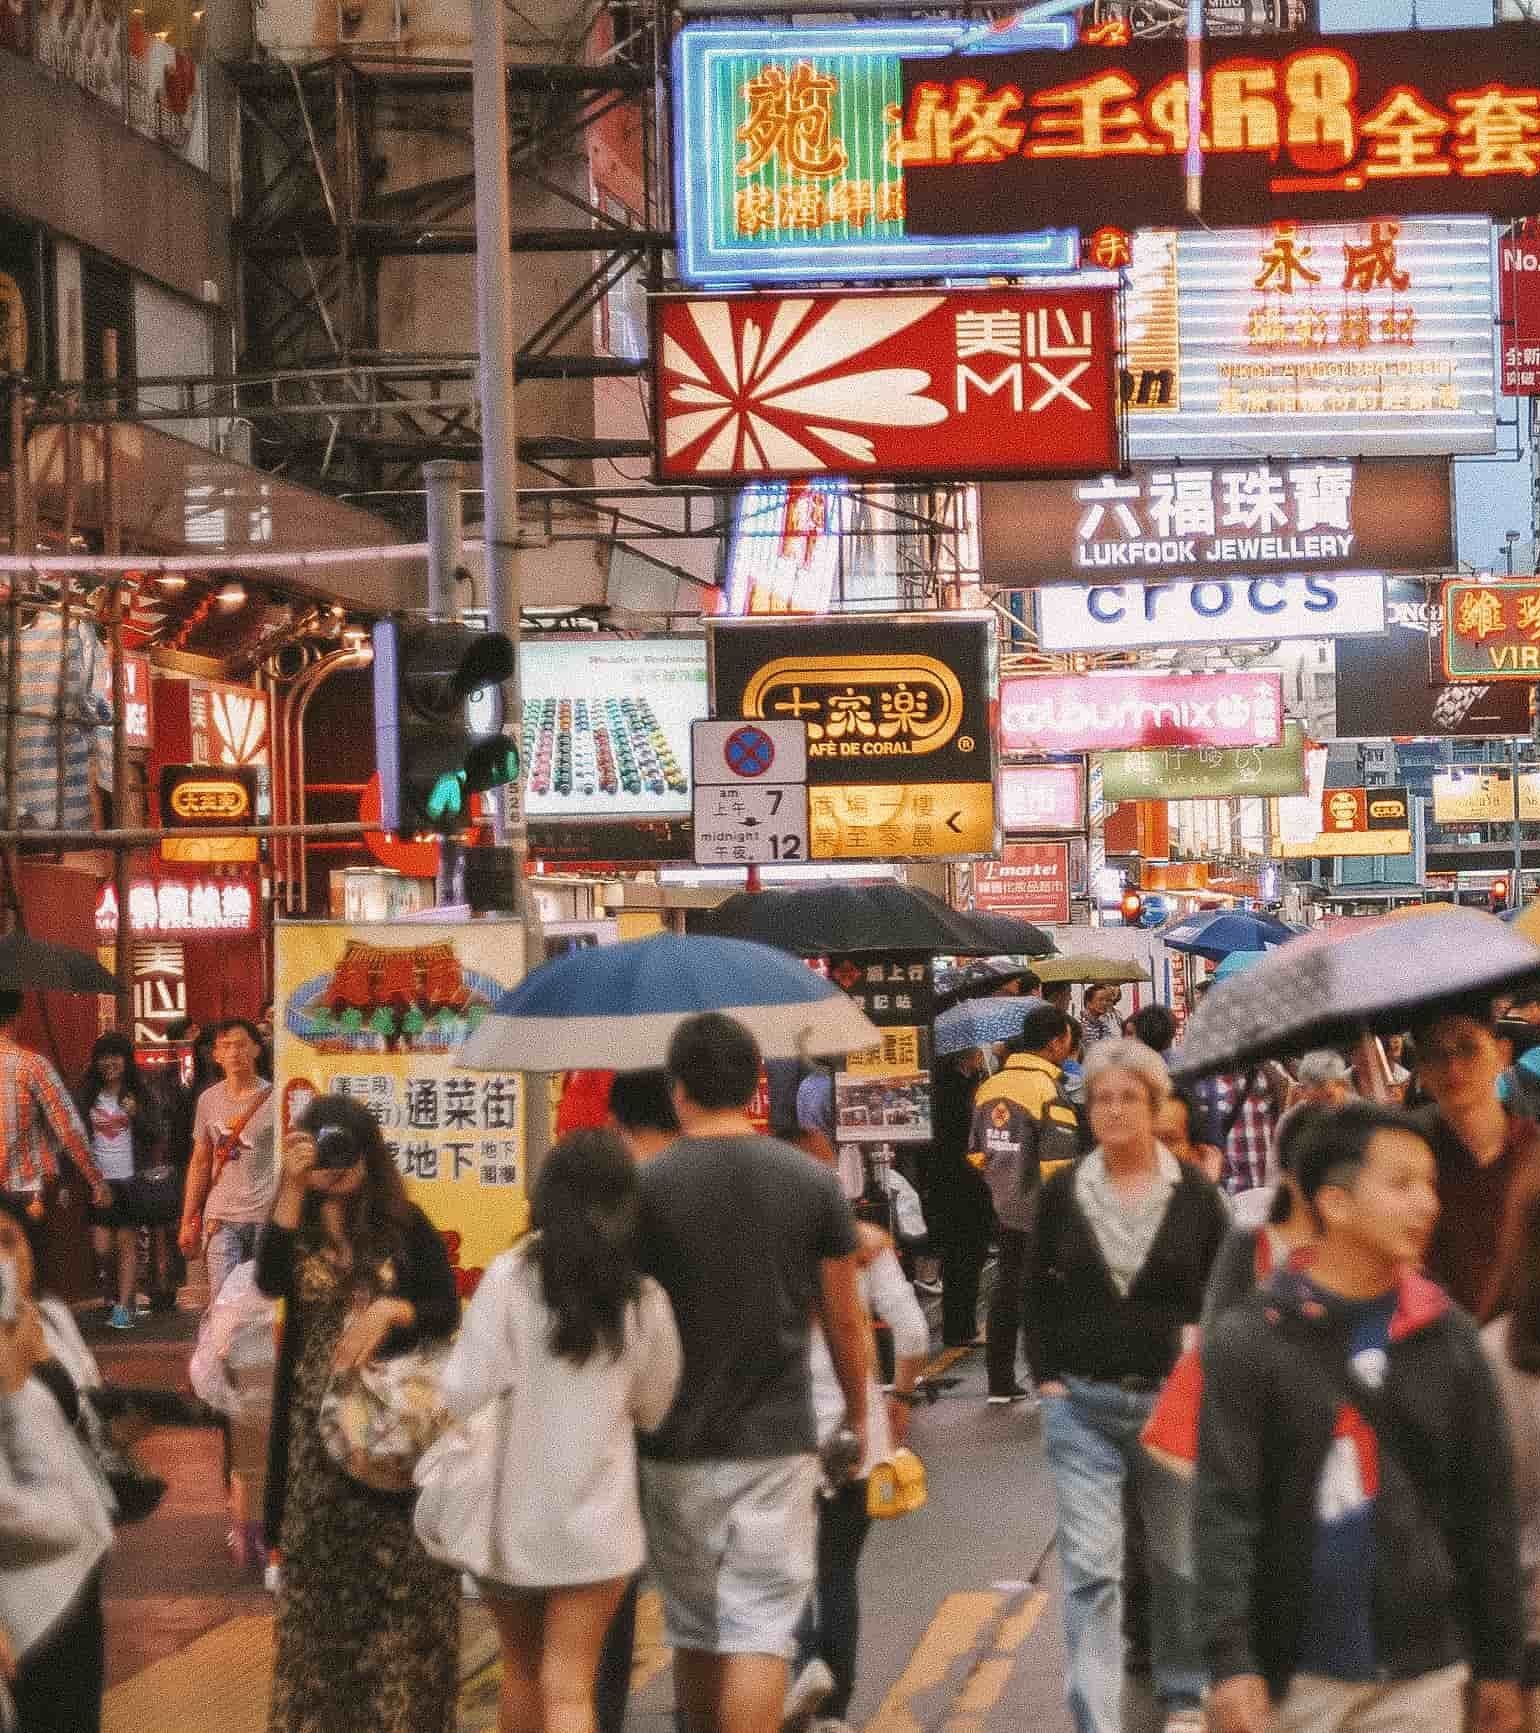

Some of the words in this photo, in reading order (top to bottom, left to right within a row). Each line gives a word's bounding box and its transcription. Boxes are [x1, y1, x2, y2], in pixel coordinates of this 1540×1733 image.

[955, 309, 1093, 358] 美心
[956, 361, 1092, 413] MX
[1076, 464, 1354, 539] 六福珠寶
[1078, 541, 1196, 567] LUKFOOK
[1207, 533, 1356, 563] JEWELLERY
[1086, 577, 1340, 624] crocs
[809, 740, 837, 756] AFÉ
[841, 742, 861, 755] DE
[864, 740, 912, 755] CORAL
[713, 801, 746, 816] 上午
[719, 789, 738, 798] am
[766, 790, 783, 815] 7
[700, 830, 760, 844] midnight
[768, 834, 801, 860] 12
[714, 845, 748, 858] 午夜
[407, 1077, 515, 1131] 通菜街
